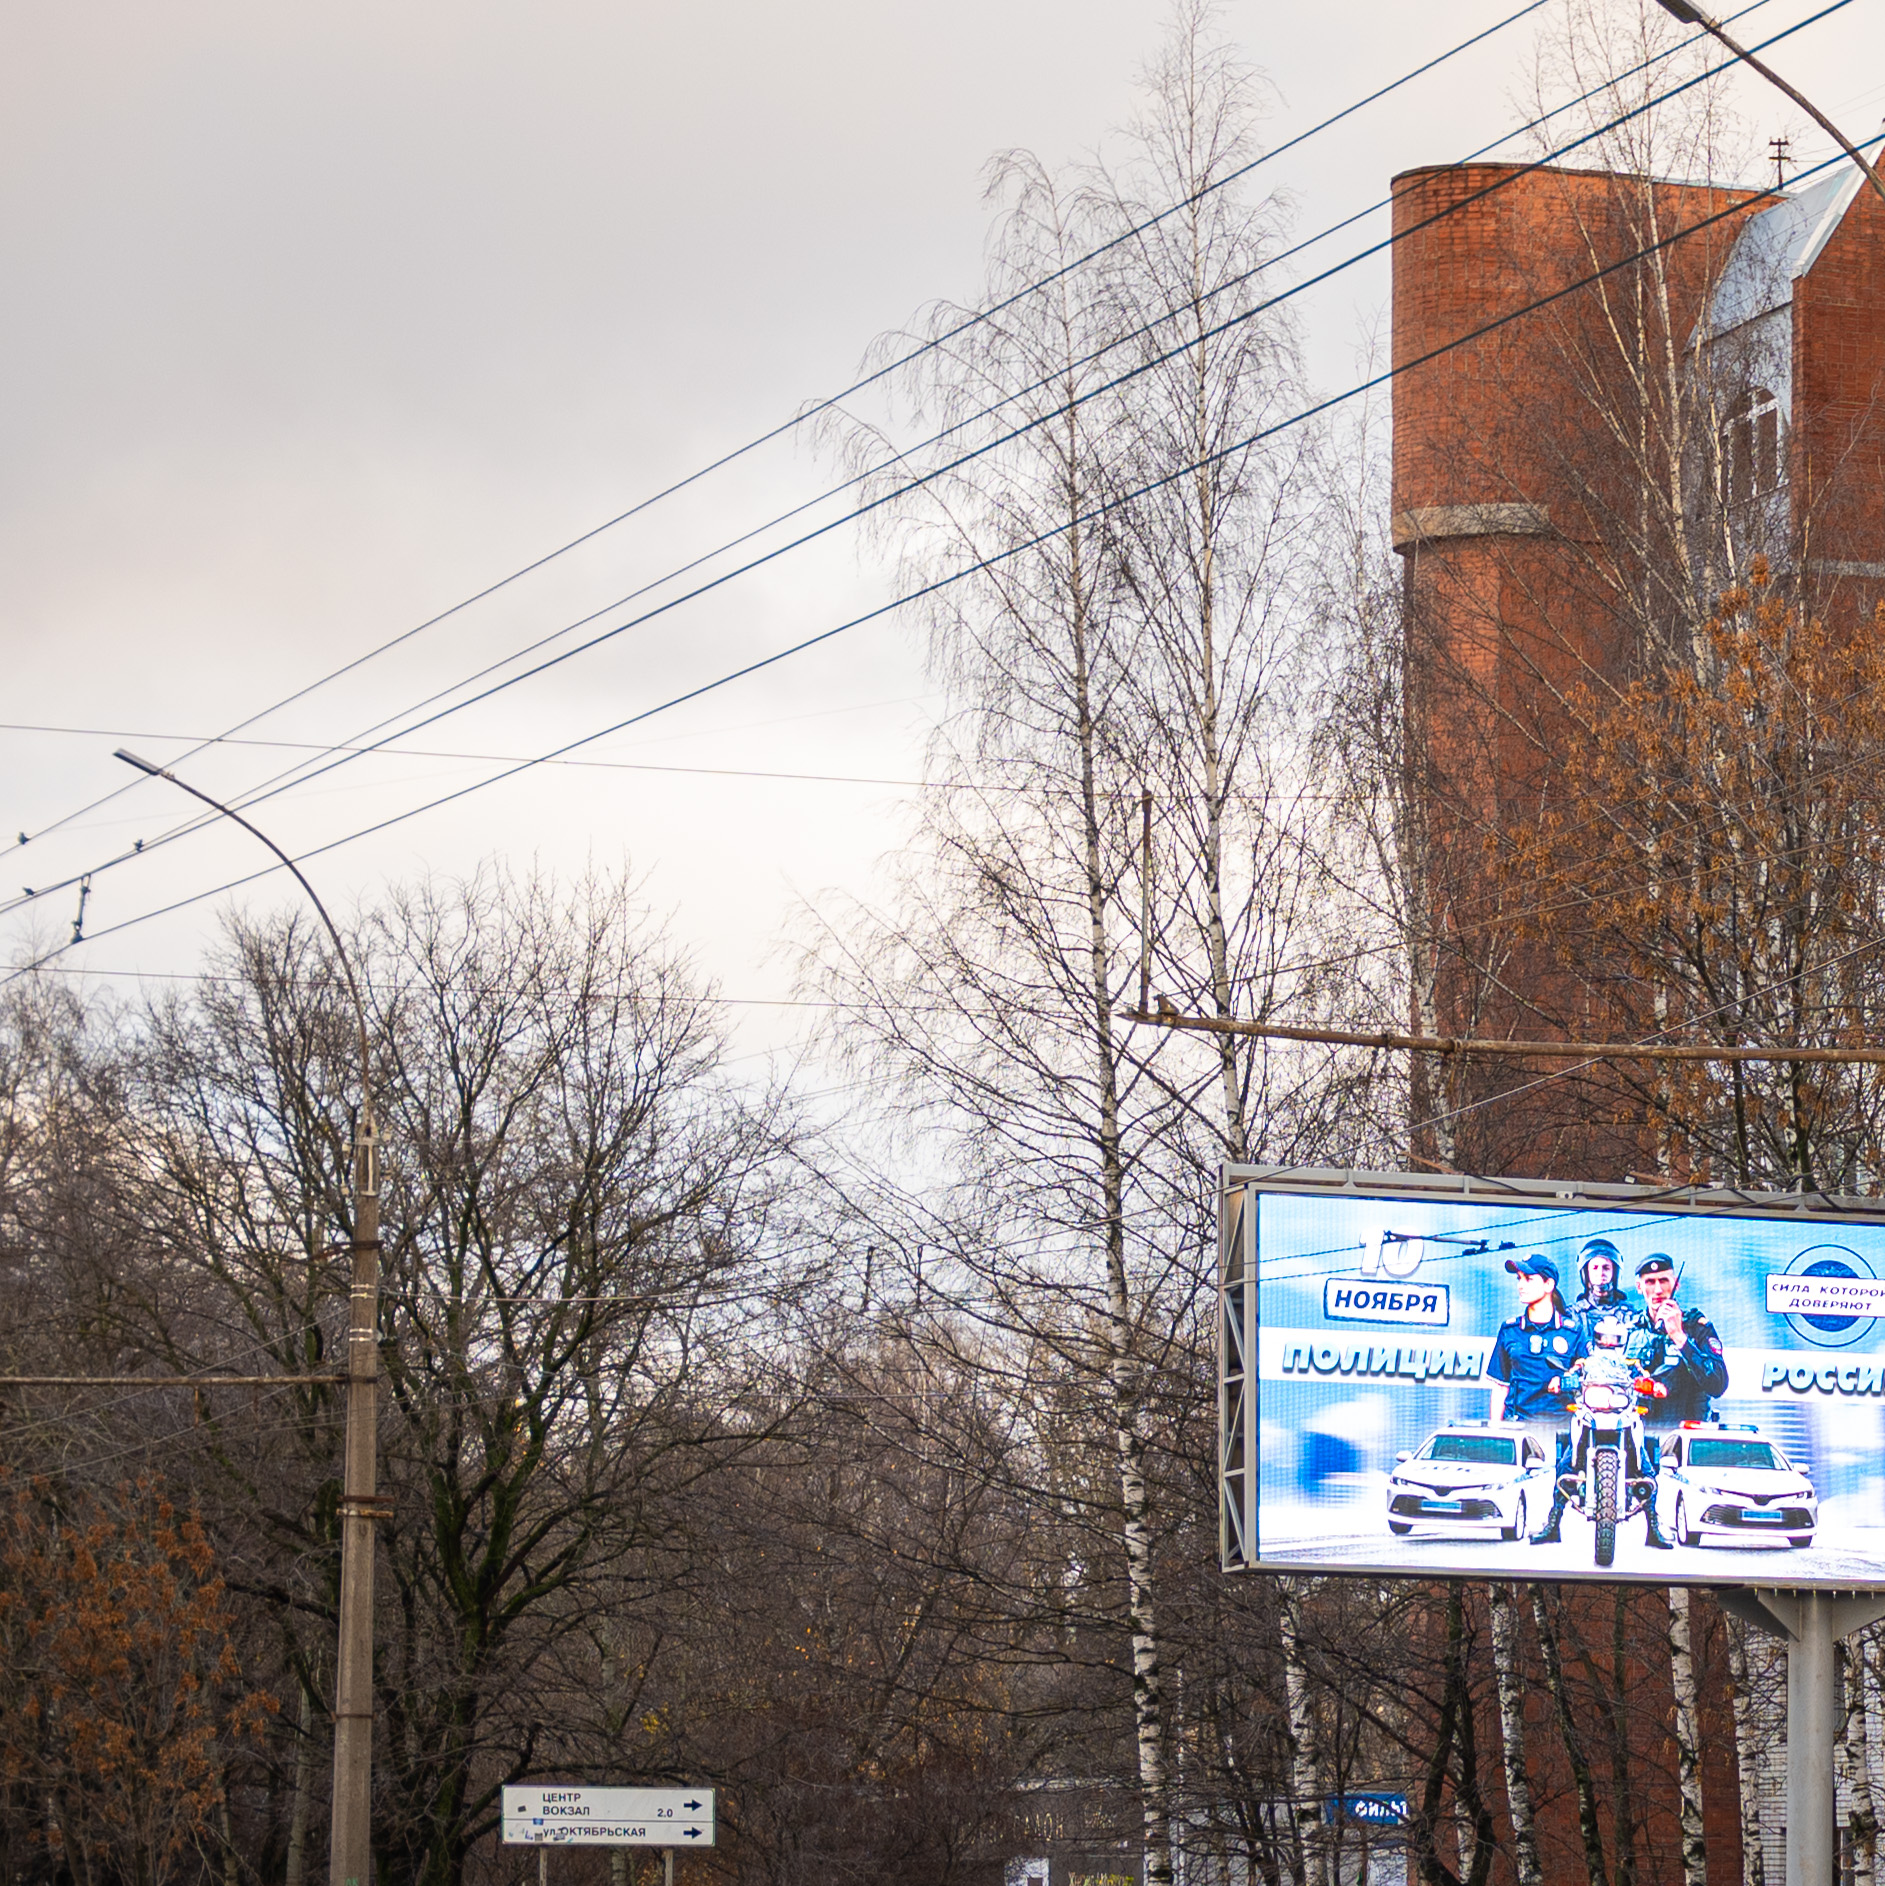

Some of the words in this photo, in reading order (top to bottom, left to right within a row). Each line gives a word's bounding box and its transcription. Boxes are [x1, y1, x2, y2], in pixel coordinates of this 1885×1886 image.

[1772, 1283, 1810, 1294] СИЛА
[1334, 1289, 1438, 1313] НОЯБРЯ
[1789, 1298, 1872, 1311] ДОВЕРЯЮТ
[1282, 1342, 1484, 1383] ПОЛИЦИЯ
[542, 1793, 581, 1804] ЦЕНТР
[542, 1805, 590, 1816] ВОКЗАЛ
[657, 1808, 674, 1818] 2.0
[560, 1826, 646, 1837] ОКТЯБРЬСКАЯ
